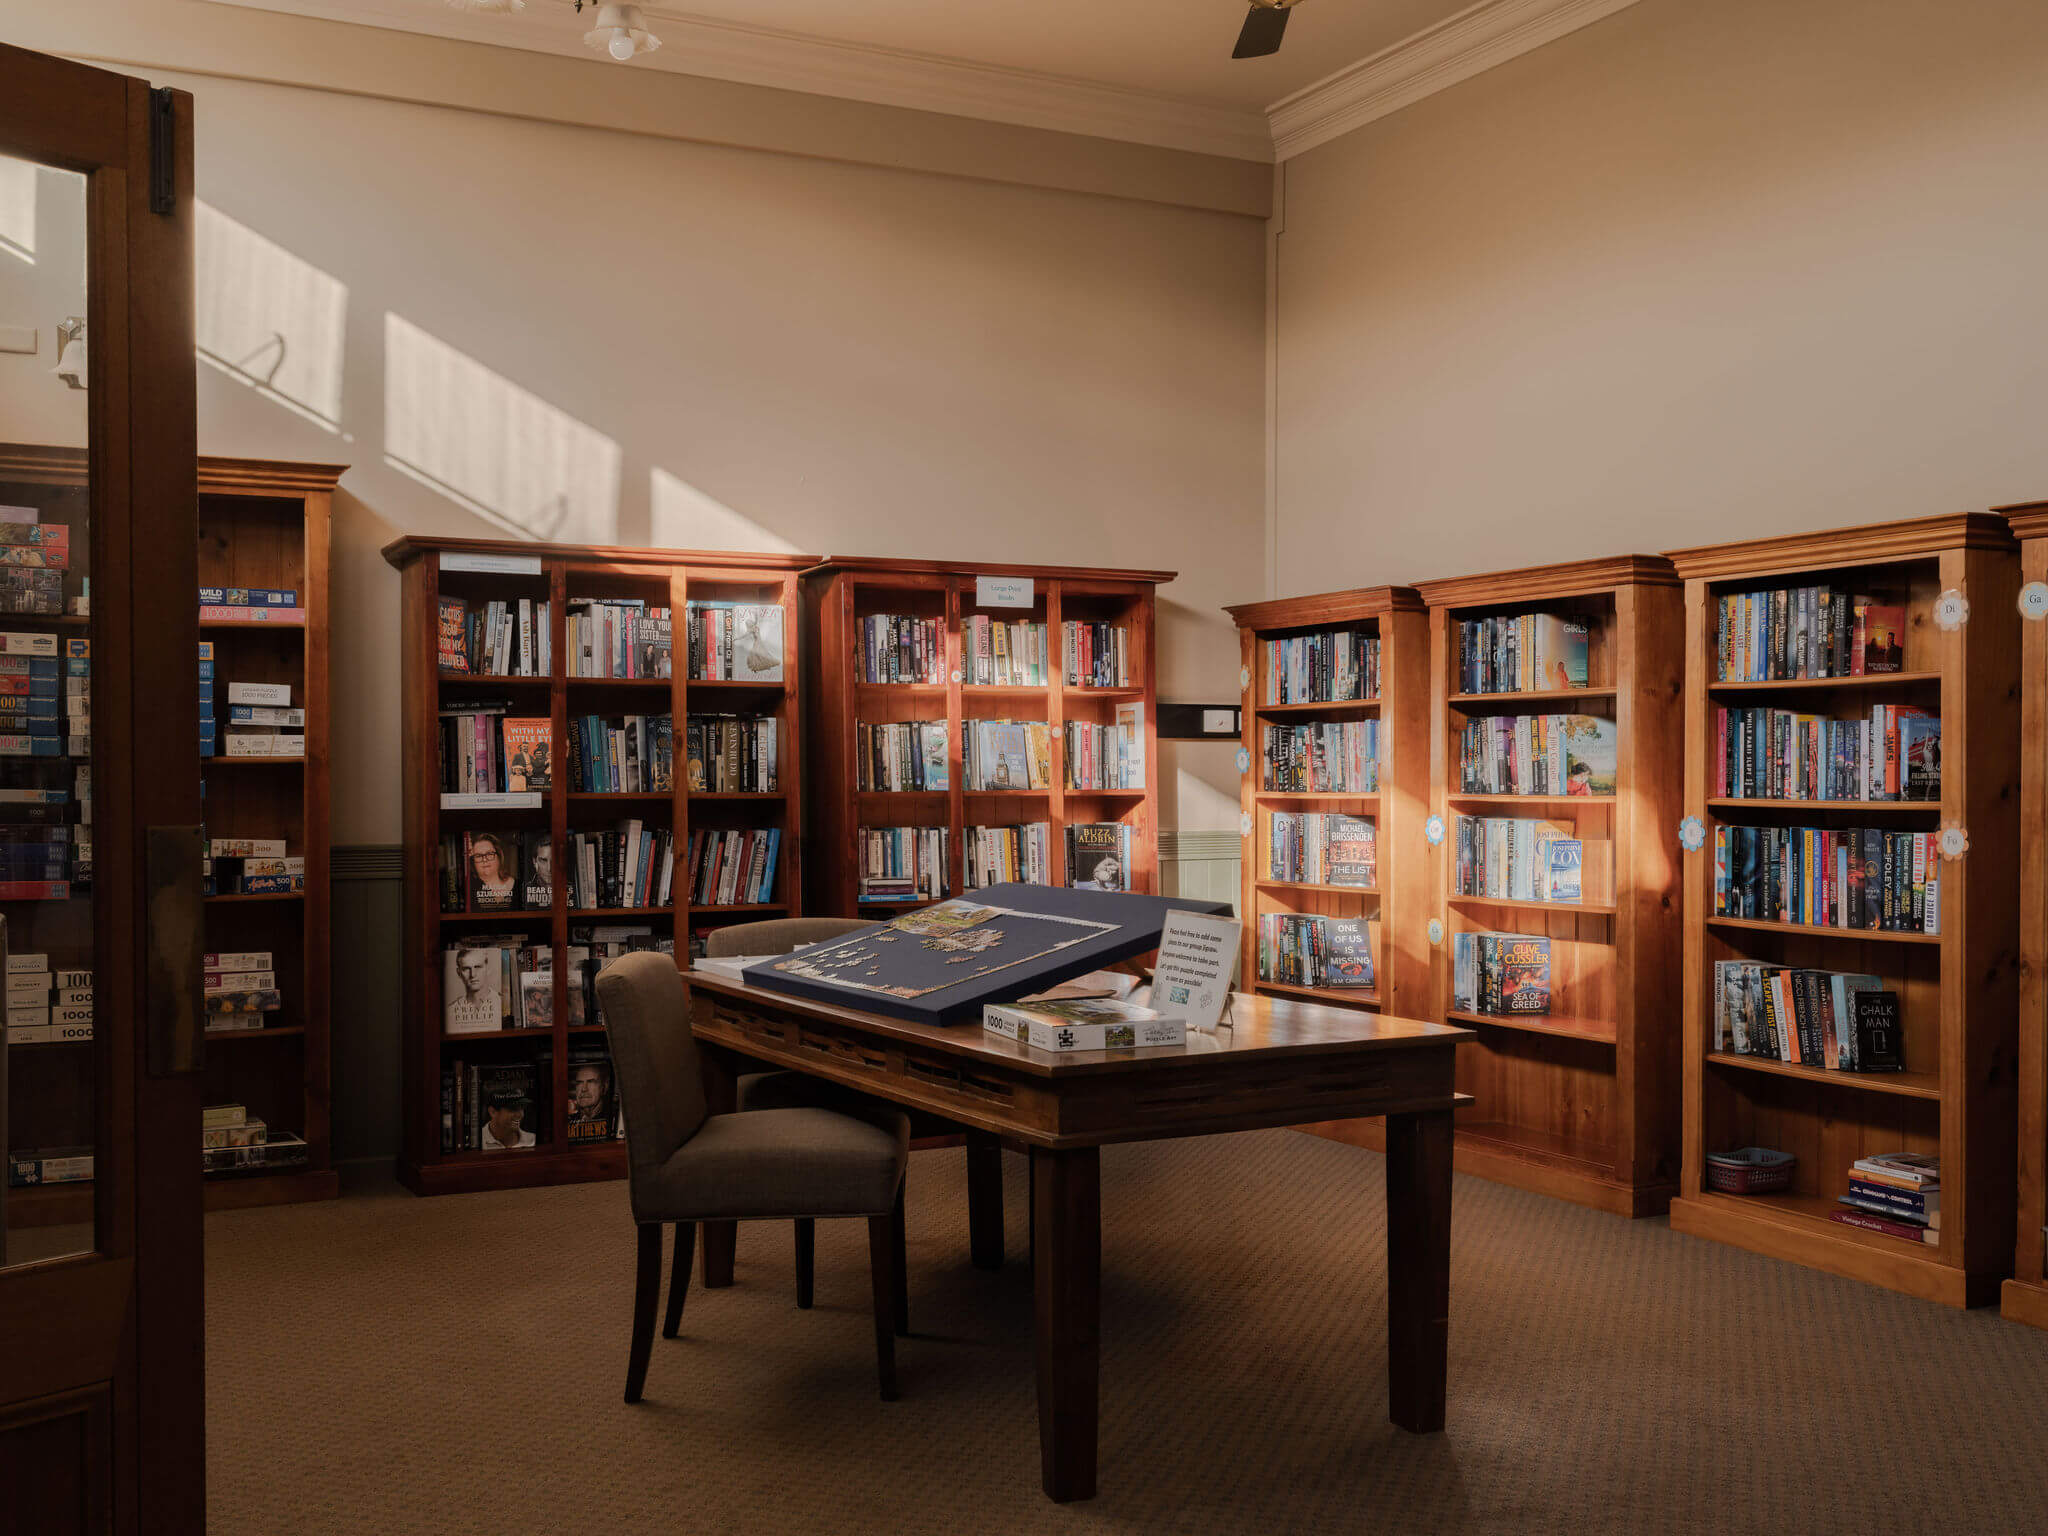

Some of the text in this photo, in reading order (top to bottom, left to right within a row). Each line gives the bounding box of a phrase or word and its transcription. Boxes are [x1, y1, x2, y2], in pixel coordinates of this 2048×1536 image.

[2029, 594, 2042, 604] Ga
[639, 619, 656, 630] LOVE
[1563, 623, 1588, 634] GIRLS
[639, 630, 661, 642] SISTER
[1745, 712, 1753, 734] WHILE
[510, 727, 550, 735] WITH MY
[1083, 827, 1111, 836] BUZZ
[1339, 823, 1365, 834] MICHAEL
[1078, 834, 1116, 843] ALDRIN
[1330, 831, 1374, 842] BRISSENDEN
[1551, 851, 1581, 865] COX
[1332, 865, 1372, 875] THE LIST
[1884, 857, 1893, 890] FOLEY
[526, 886, 546, 895] BEAR
[1337, 924, 1358, 933] ONE
[1334, 935, 1363, 944] OF US
[1344, 945, 1354, 954] IS
[1512, 942, 1541, 955] CLIVE
[1330, 956, 1371, 965] MISSING
[1504, 953, 1550, 965] CUSSLER
[204, 976, 218, 985] 500
[1512, 991, 1541, 1001] SEA OF
[1511, 1000, 1542, 1010] GREED
[1762, 978, 1777, 1028] ESCAPE ARTIST
[1798, 997, 1808, 1029] FRENCH
[1860, 1005, 1893, 1016] CHALK
[986, 1013, 1003, 1030] 1000
[1866, 1017, 1891, 1028] MAN
[1841, 1215, 1861, 1226] Vintage
